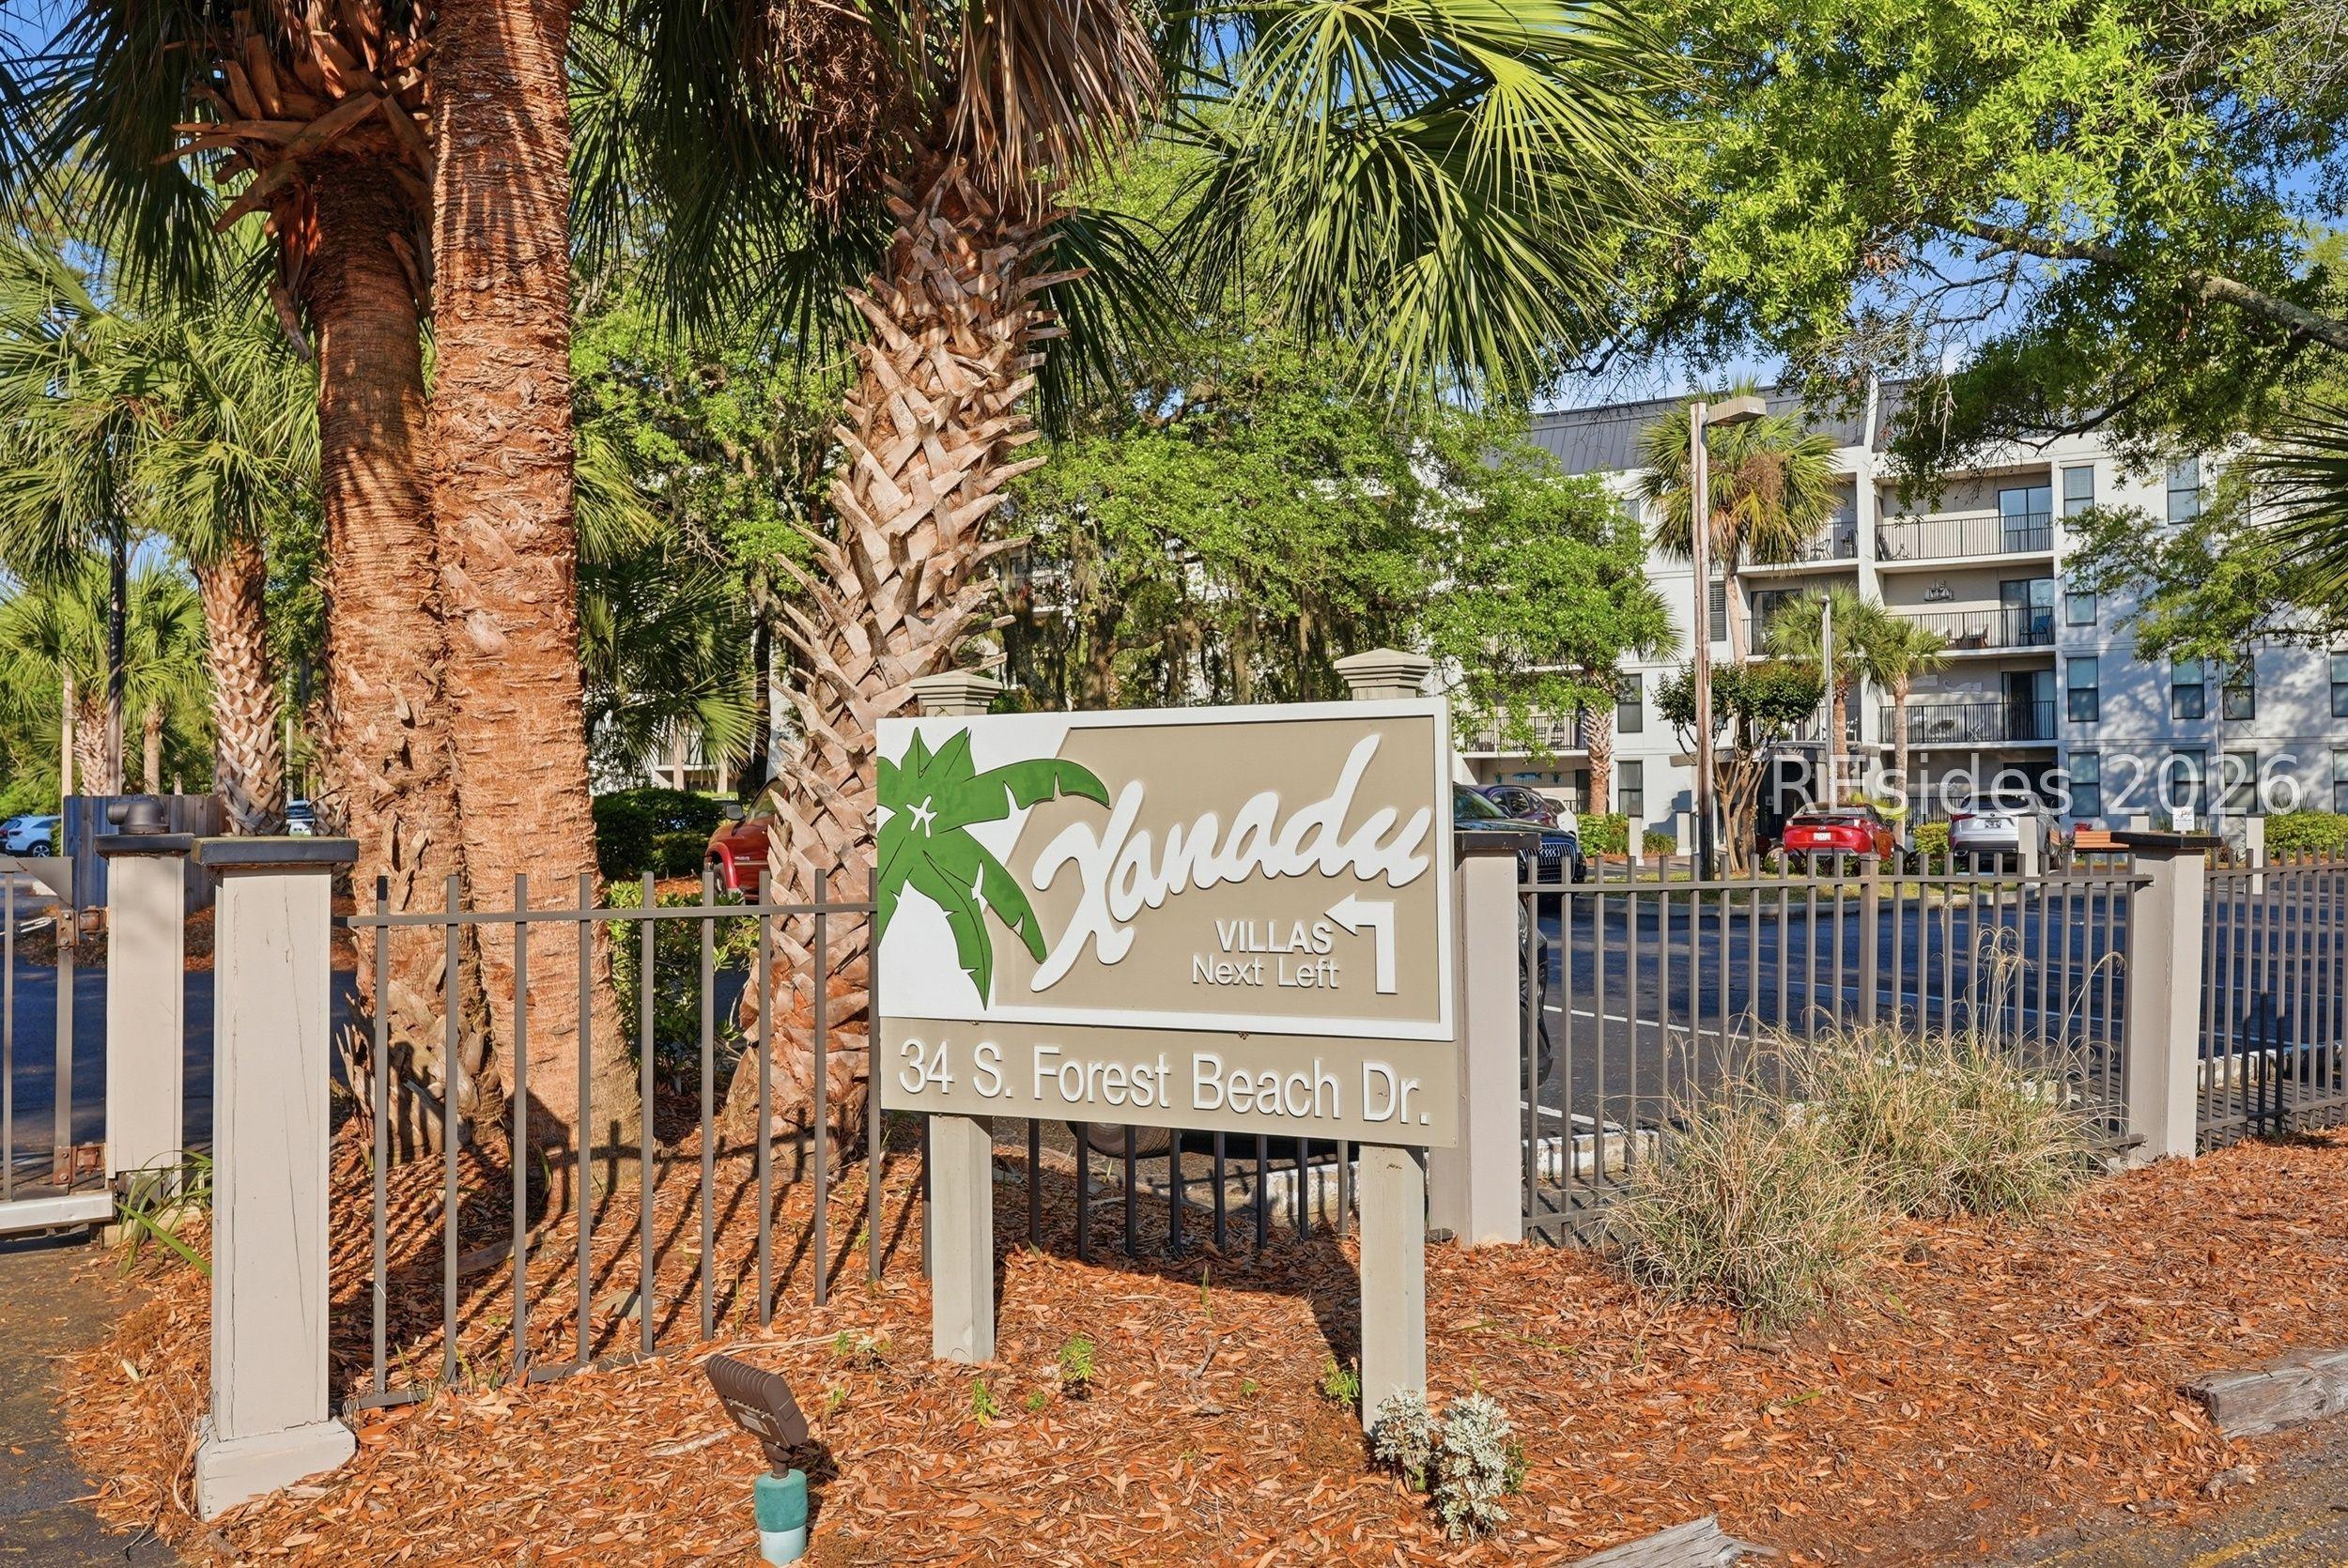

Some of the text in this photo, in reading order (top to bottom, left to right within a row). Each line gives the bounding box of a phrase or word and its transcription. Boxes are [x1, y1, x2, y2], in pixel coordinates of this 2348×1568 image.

[1030, 734, 1432, 992] Xanadu
[1215, 920, 1334, 954] VILLAS
[1192, 955, 1339, 989] Next Left
[898, 1038, 1430, 1126] 34 S. Forest Beach Dr.
